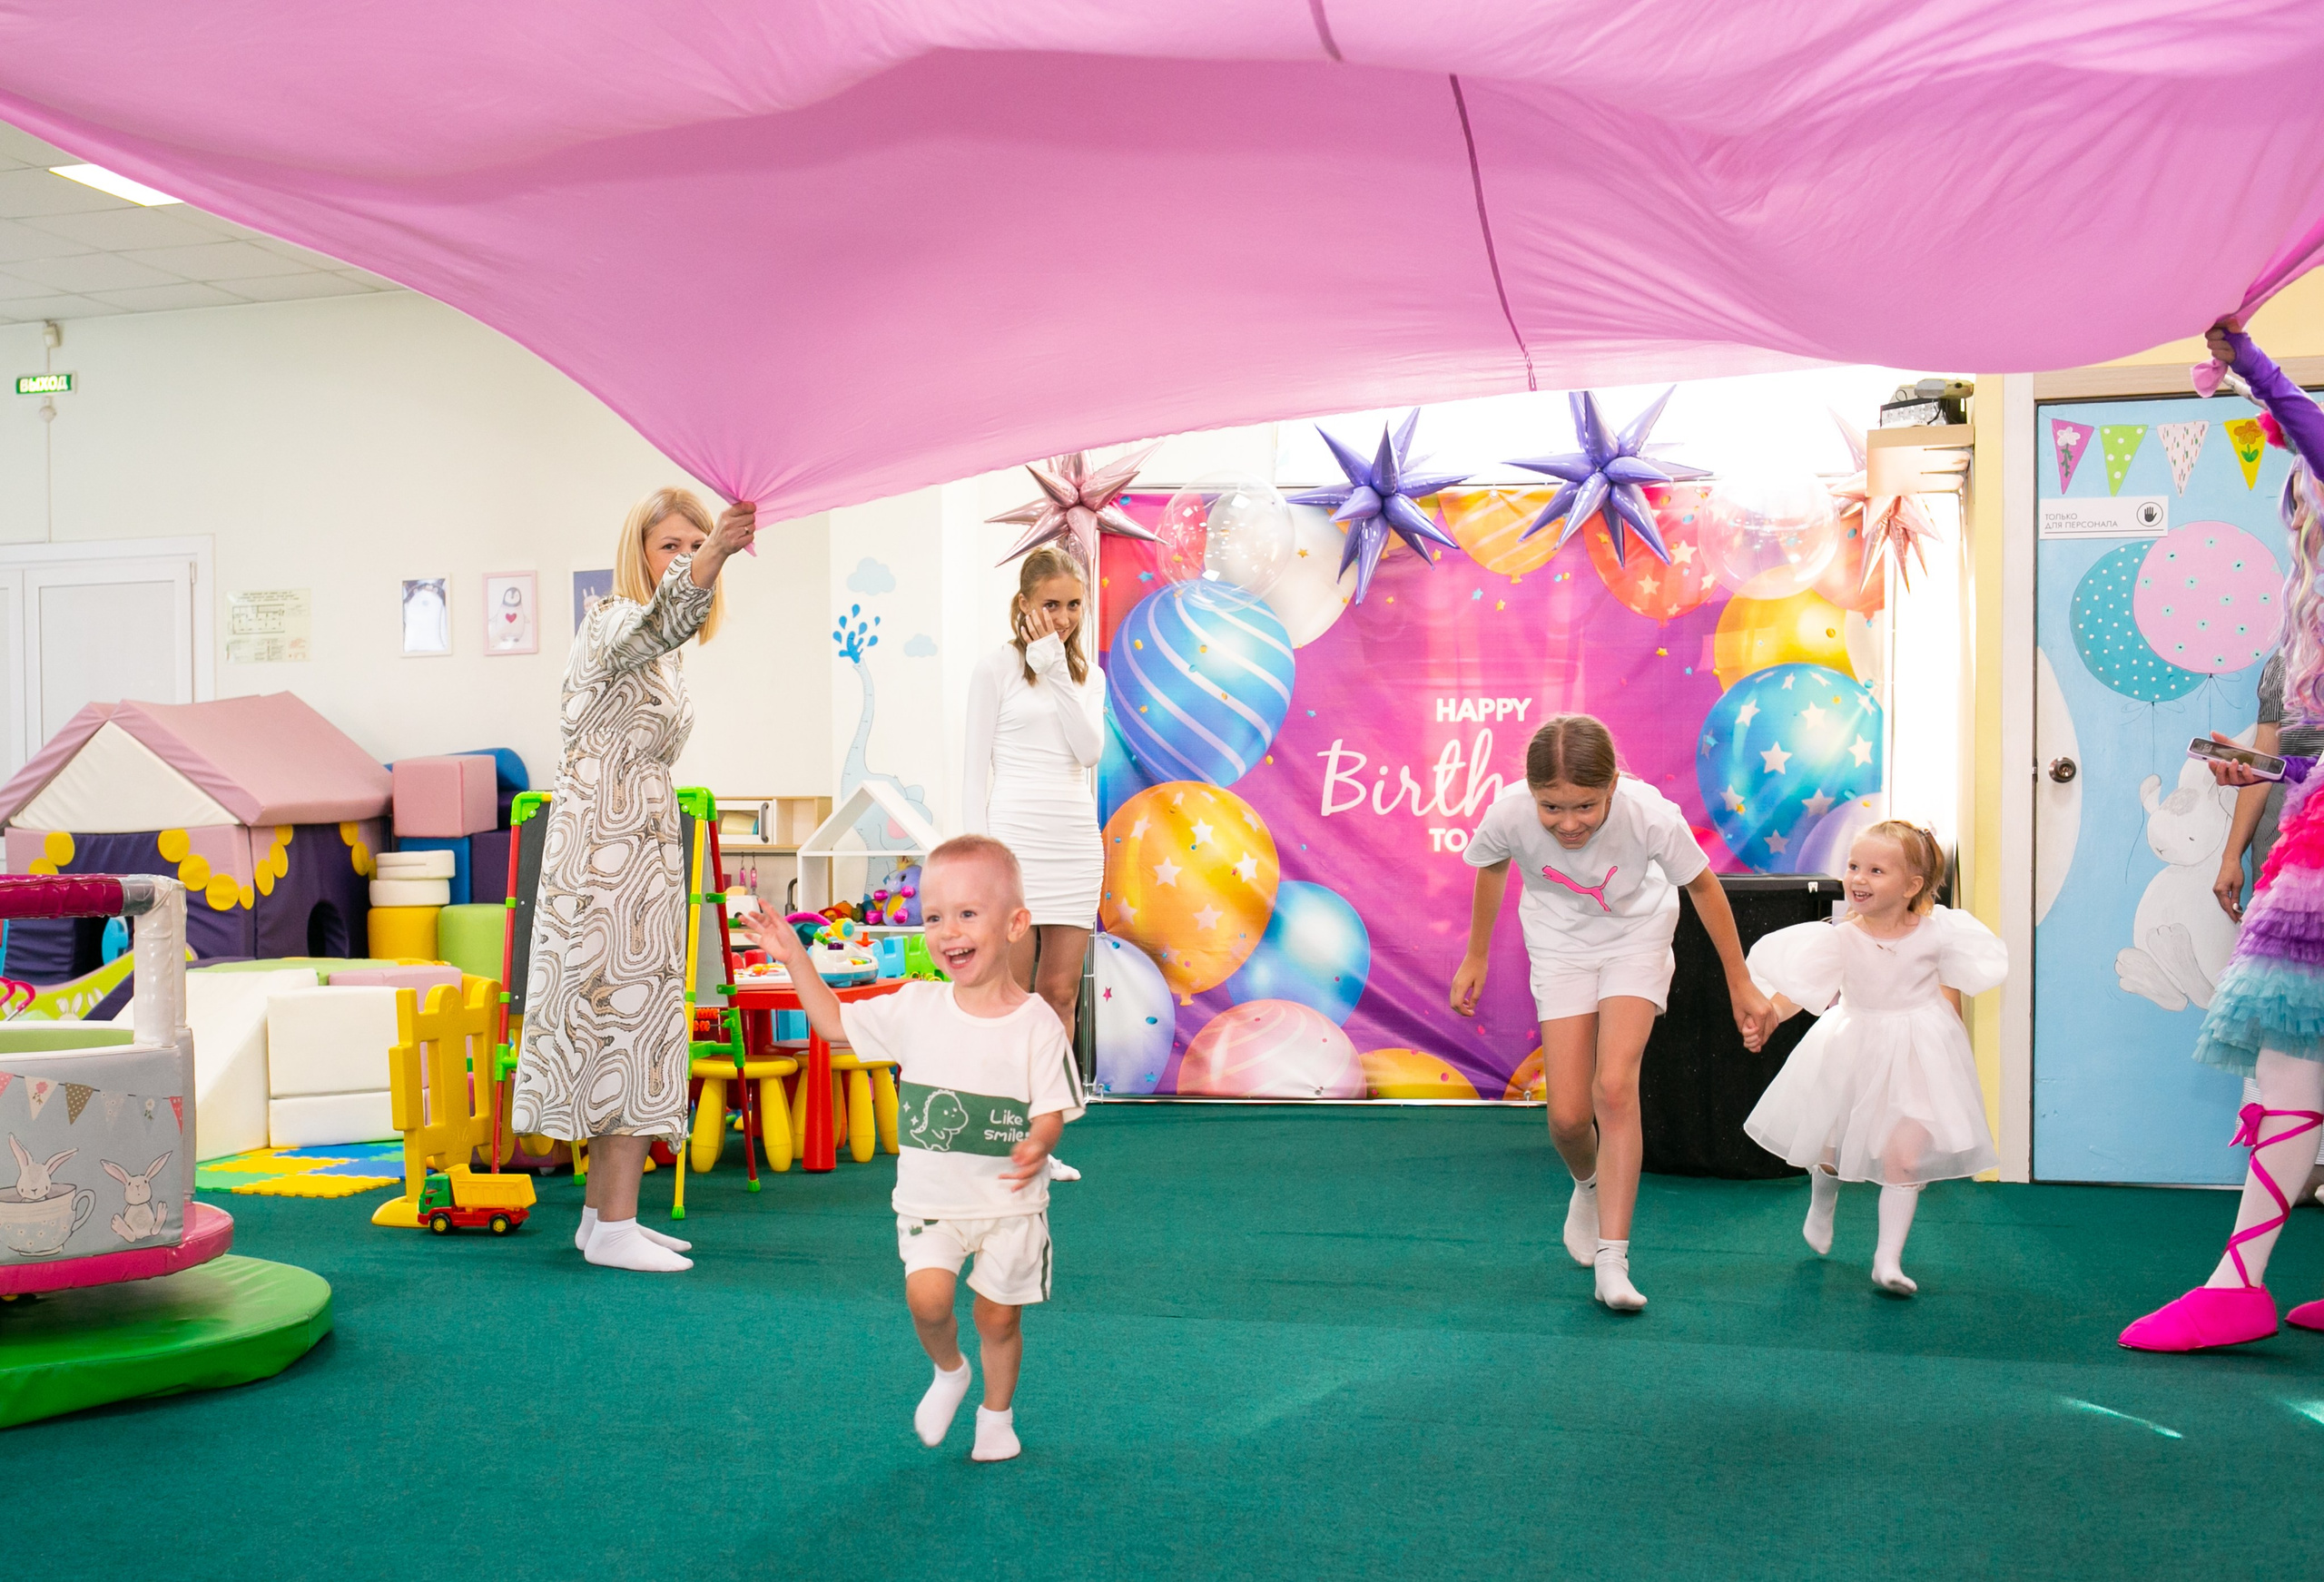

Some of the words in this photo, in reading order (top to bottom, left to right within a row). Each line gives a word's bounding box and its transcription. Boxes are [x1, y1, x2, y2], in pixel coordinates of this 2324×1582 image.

[19, 375, 69, 393] ВЫХОД
[2044, 513, 2078, 521] ТОЛЬКО
[2044, 522, 2063, 530] ДЛЯ
[2064, 520, 2119, 529] ПЕРСОНАЛА
[1436, 697, 1532, 722] HAPPY
[1316, 727, 1503, 818] Birth
[1428, 827, 1469, 852] TO
[990, 1109, 1023, 1125] Like
